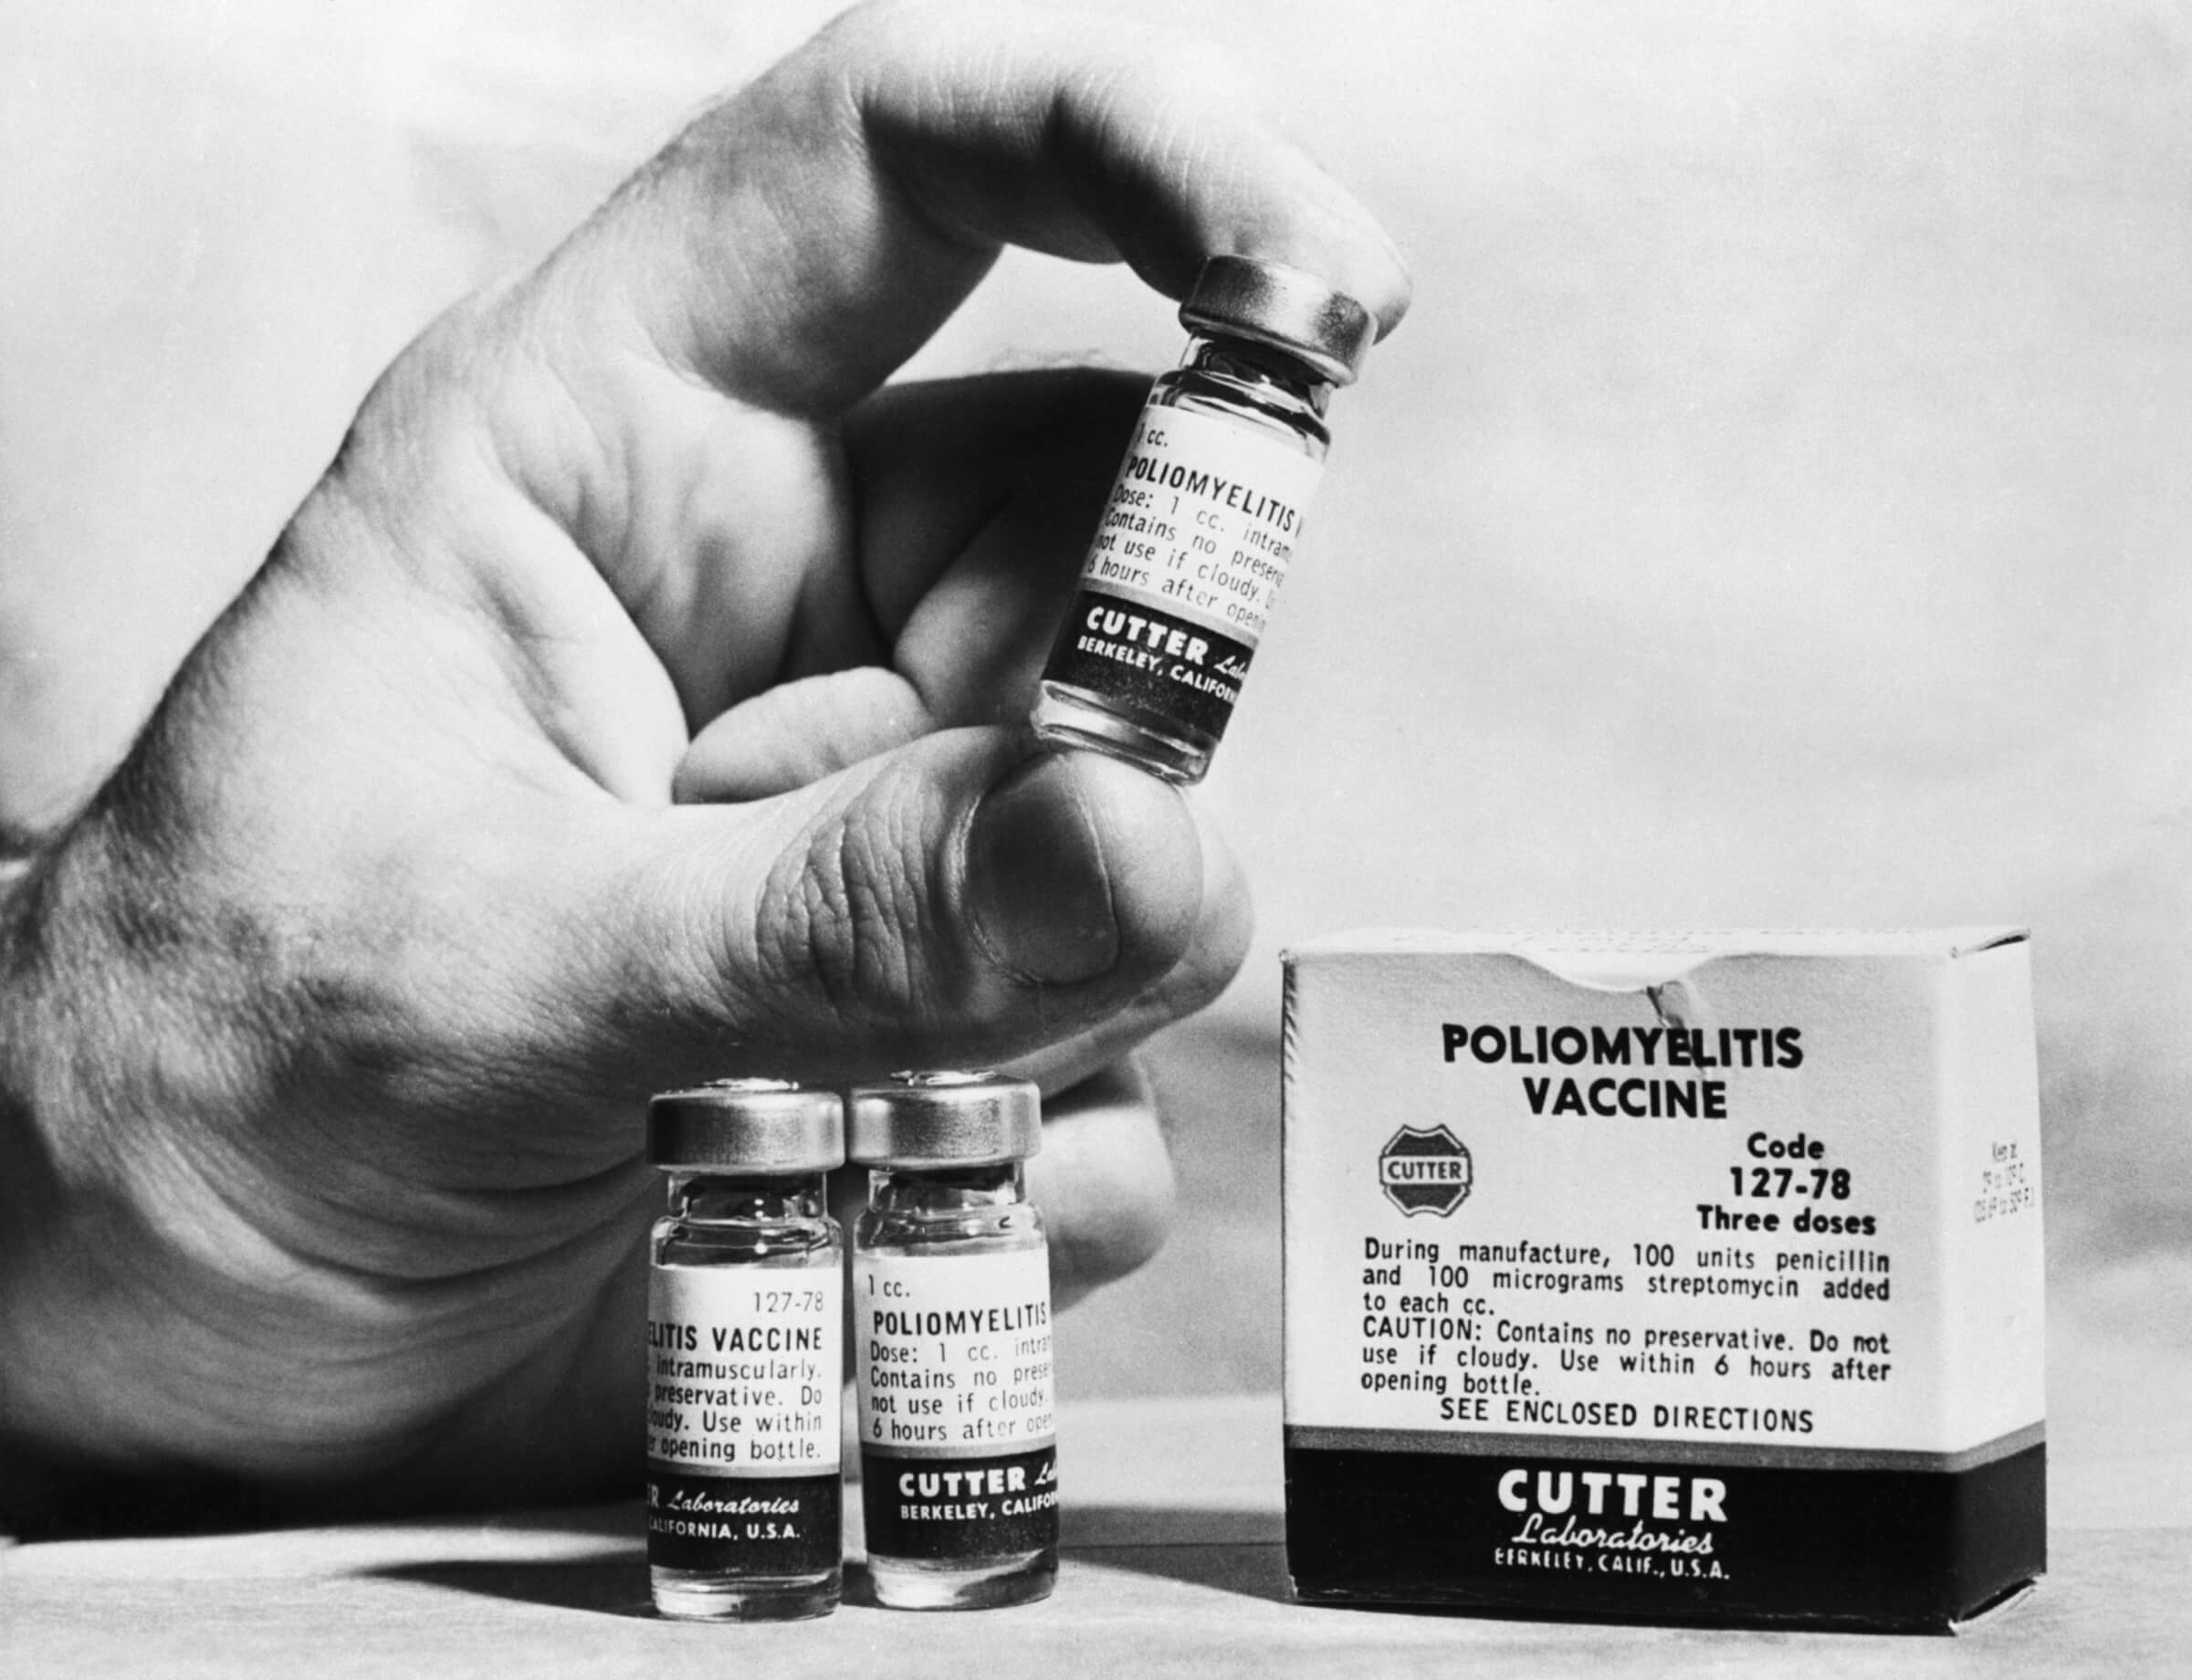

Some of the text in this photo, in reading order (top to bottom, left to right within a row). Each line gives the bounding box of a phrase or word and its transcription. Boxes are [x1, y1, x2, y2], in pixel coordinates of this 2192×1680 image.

[1147, 430, 1168, 446] cc.
[1114, 483, 1153, 509] Dose:
[1170, 497, 1179, 514] 1
[1196, 510, 1224, 531] cc.
[1126, 456, 1295, 531] POLIOMYELITIS
[1105, 507, 1176, 541] Contains
[1192, 535, 1217, 554] no
[1100, 555, 1149, 585] hours
[1125, 540, 1156, 561] use
[1168, 549, 1189, 569] if
[1198, 563, 1260, 603] cloudy.
[1086, 606, 1209, 666] CUTTER
[1077, 635, 1164, 676] BERKELEY,
[1442, 1023, 1804, 1068] POLIOMYELITIS
[1523, 1077, 1727, 1118] VACCINE
[1746, 1132, 1826, 1160] Code
[1387, 1160, 1463, 1180] CUTTER
[1730, 1167, 1851, 1200] 127-78
[1696, 1204, 1877, 1235] Three doses
[1365, 1237, 1890, 1273] During manufacture, 100 units penicillin
[868, 1275, 911, 1297] 1 cc.
[1362, 1265, 1891, 1301] and 100 micrograms streptomycin added
[754, 1291, 825, 1313] 127-78
[1363, 1292, 1495, 1316] to each cc.
[873, 1301, 1047, 1337] POLIOMYELITIS
[712, 1327, 823, 1352] VACCINE
[870, 1336, 1051, 1363] Dose: 1 cc. intra
[1363, 1315, 1892, 1355] CAUTION: Contains no preservative. Do not
[656, 1354, 823, 1381] intramuscularly.
[870, 1362, 1050, 1389] Contains no prese
[1362, 1344, 1893, 1381] use if cloudy. Use within 6 hours after
[655, 1382, 823, 1407] preservative. Do
[1360, 1370, 1541, 1397] opening bottle.
[872, 1387, 1048, 1414] not use if cloudy.
[1440, 1397, 1814, 1433] SEE ENCLOSED DIRECTIONS
[703, 1410, 742, 1433] Use
[754, 1412, 823, 1433] within
[873, 1417, 882, 1438] 6
[891, 1418, 947, 1440] hours
[661, 1437, 736, 1463] opening
[750, 1439, 822, 1461] bottle.
[898, 1466, 1025, 1497] CUTTER
[1498, 1469, 1728, 1522] CUTTER
[667, 1490, 800, 1515] Laboratories
[901, 1503, 995, 1520] BERKELEY,
[747, 1523, 801, 1539] U.S.A.
[1512, 1513, 1714, 1554] Laboratories
[1671, 1558, 1731, 1580] U.S.A.
